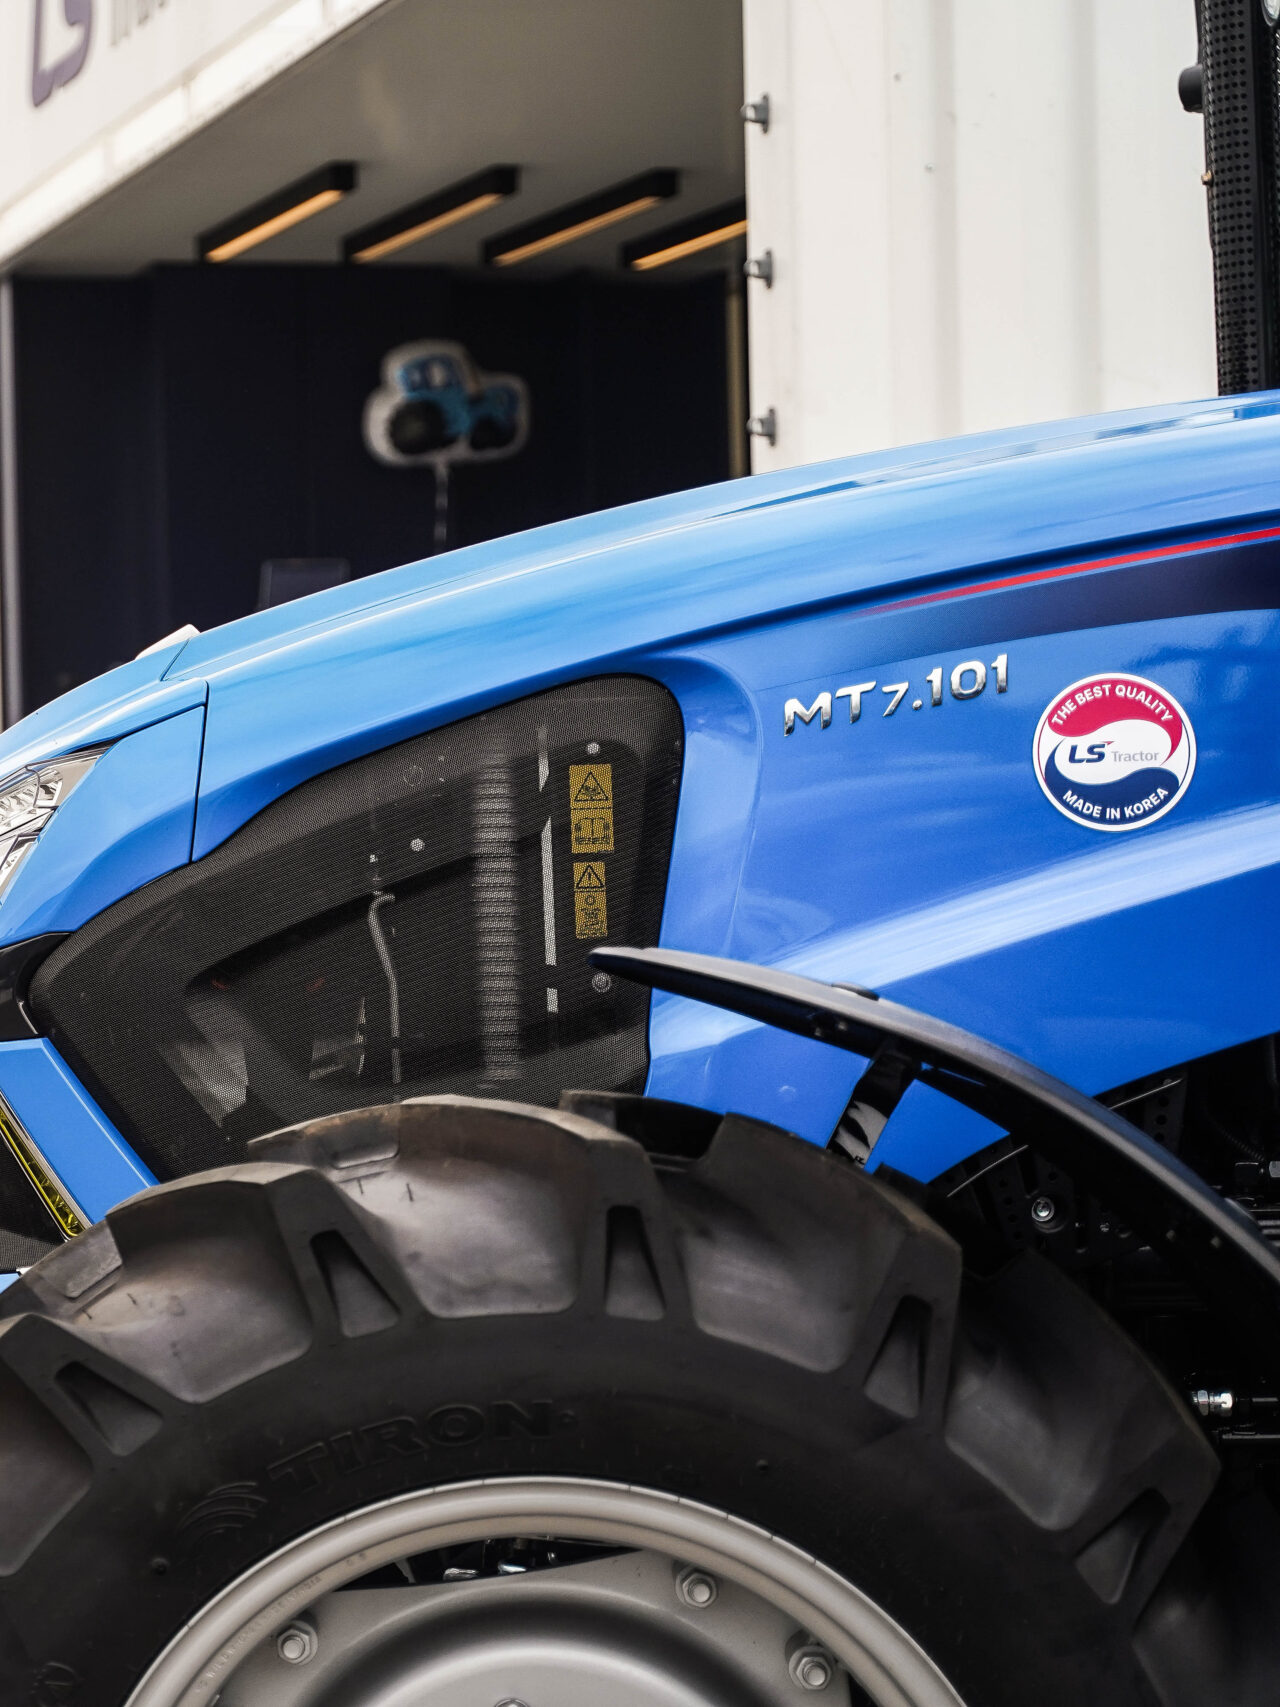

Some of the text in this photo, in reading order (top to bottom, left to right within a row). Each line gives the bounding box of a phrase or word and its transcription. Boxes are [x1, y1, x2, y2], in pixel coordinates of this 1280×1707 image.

[1051, 684, 1174, 726] THE BEST QUALITY
[1068, 742, 1160, 764] LS Tractor
[1062, 787, 1169, 820] MADE IN KOREA
[267, 1399, 554, 1494] TIRON
